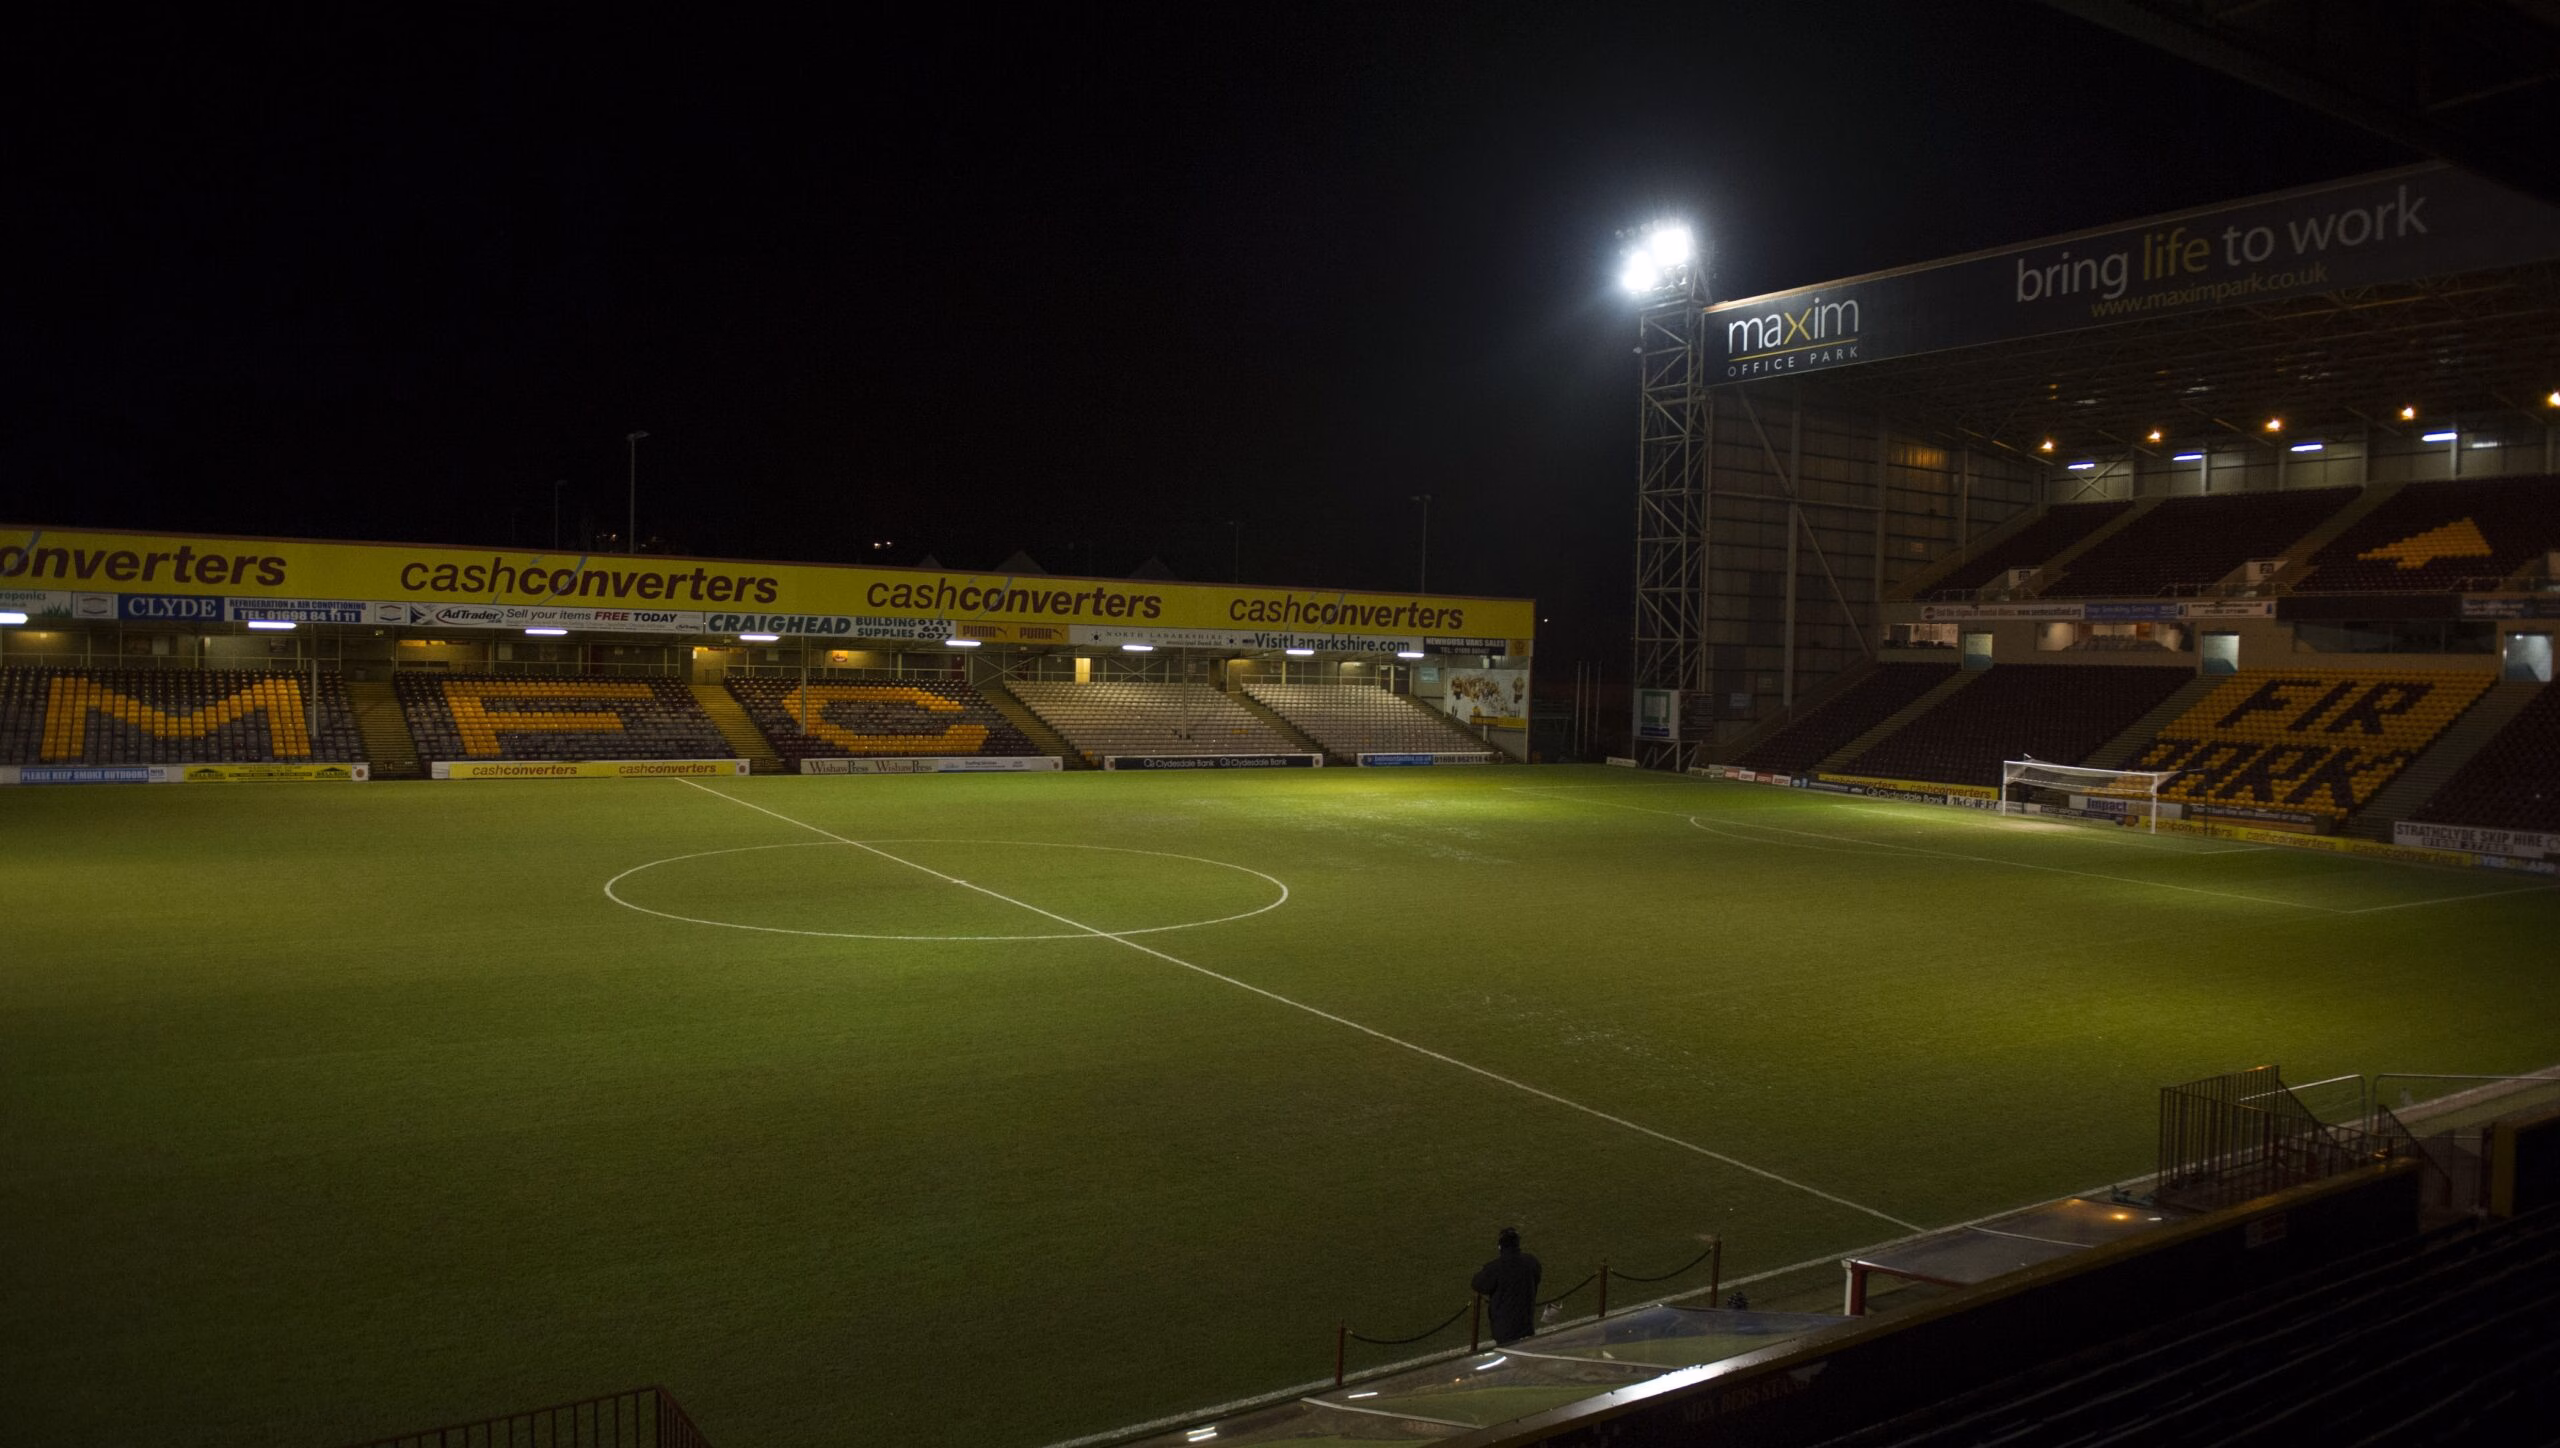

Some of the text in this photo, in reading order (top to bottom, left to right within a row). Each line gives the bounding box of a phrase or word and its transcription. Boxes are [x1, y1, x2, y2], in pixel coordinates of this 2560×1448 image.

[2017, 184, 2428, 302] bring life to work
[2090, 261, 2328, 317] www.maximpark.co.uk
[1729, 297, 1859, 354] maxim
[1728, 346, 1858, 377] OFFICE PARK
[400, 557, 778, 602] cashconverters
[229, 599, 288, 608] REFRIGERATION
[297, 600, 310, 609] AIR
[311, 601, 366, 610] CONDITIONING
[867, 577, 1162, 618] cashconverters
[128, 597, 216, 617] CLYDE
[1229, 594, 1464, 629] cashconverters
[240, 609, 264, 620] TEL:
[267, 610, 307, 621] 01698
[310, 610, 326, 621] 84
[442, 610, 499, 620] AdTrader
[506, 609, 677, 622] Sell your items FREE TODAY
[856, 617, 916, 627] BUILDING
[709, 614, 851, 634] CRAIGHEAD
[963, 625, 996, 638] PUMA
[857, 628, 914, 638] SUPPLIES
[1020, 627, 1052, 639] PUMA
[1150, 632, 1221, 640] LANARKSHIRE
[1255, 632, 1409, 652] VisitLanarkshire.com
[2215, 680, 2433, 733] FIR
[472, 764, 577, 776] cashconverters
[619, 763, 717, 774] cashconverters
[1156, 759, 1215, 768] Clydesdale Bank
[1231, 758, 1287, 767] Clydesdale Bank
[22, 770, 148, 781] PLEASE KEEP SMOKE OUTDOORS
[1878, 789, 1921, 802] Clydesdale
[1923, 794, 1944, 804] Bank
[2087, 797, 2128, 813] Impact
[2246, 829, 2336, 850] cashconverters
[2396, 824, 2545, 847] STRATHCLYDE SKIP HIRE
